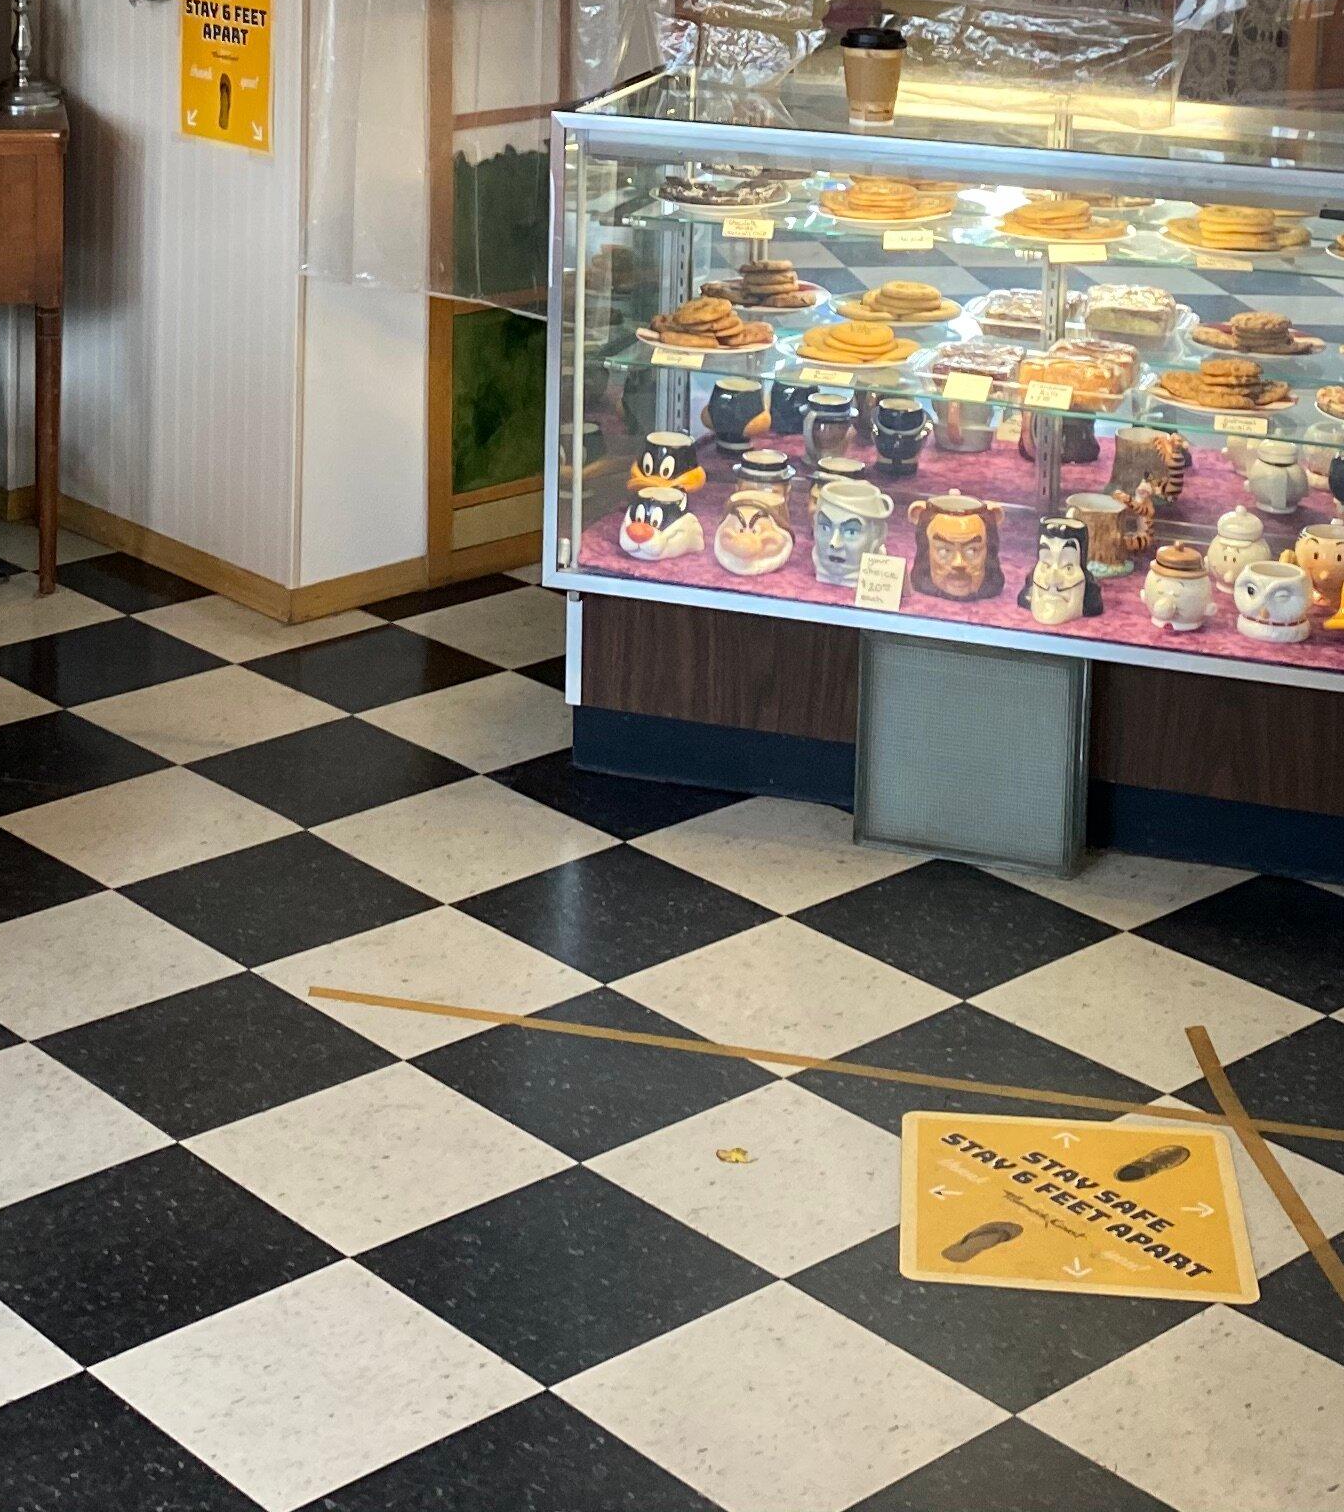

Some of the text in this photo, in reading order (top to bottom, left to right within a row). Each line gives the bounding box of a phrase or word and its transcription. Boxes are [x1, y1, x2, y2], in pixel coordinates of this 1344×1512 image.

[202, 22, 249, 46] APART
[222, 3, 232, 22] 6
[234, 4, 268, 28] FEET
[941, 1133, 1018, 1171] STAY
[1011, 1169, 1040, 1185] 6
[1033, 1181, 1114, 1223] FEET
[1106, 1223, 1214, 1277] APART
[1022, 1151, 1100, 1189] STAY
[1093, 1188, 1177, 1234] SAFE
